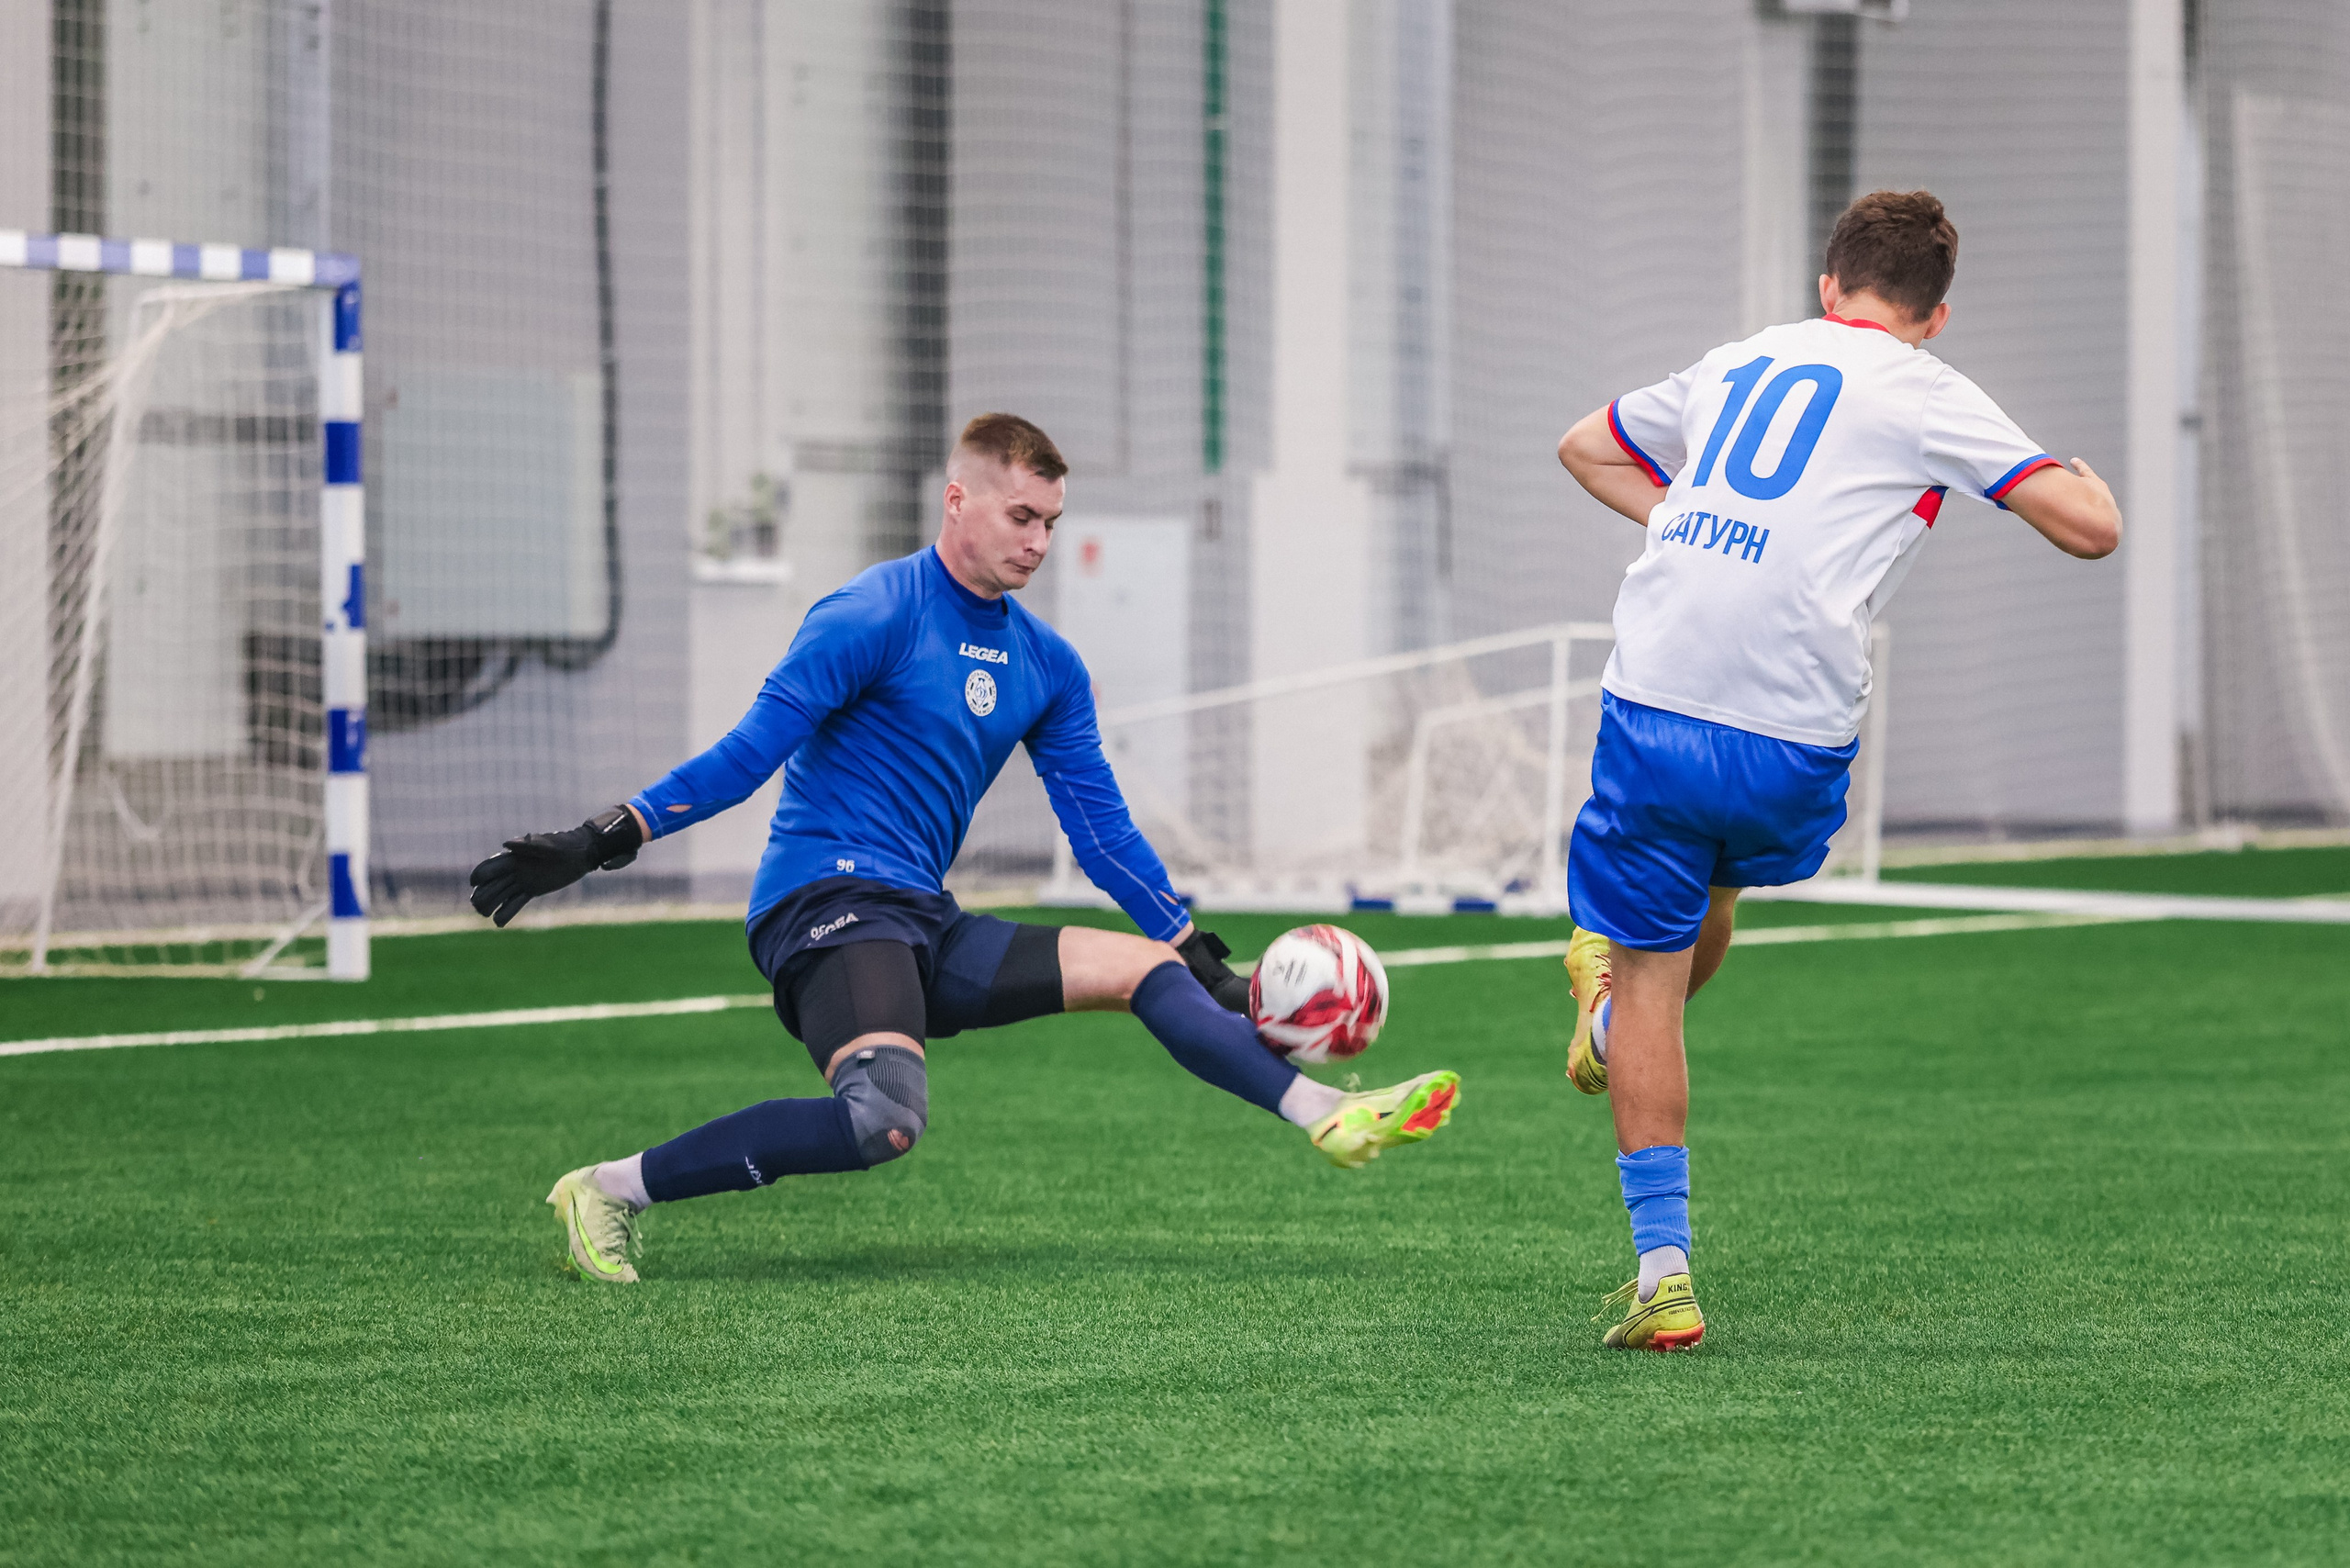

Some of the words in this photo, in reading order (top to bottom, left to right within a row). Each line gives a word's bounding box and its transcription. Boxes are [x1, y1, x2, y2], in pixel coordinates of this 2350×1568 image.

[1692, 355, 1843, 500] 10
[1661, 511, 1770, 564] САТУРН
[958, 642, 1008, 665] LEGEA
[836, 858, 855, 873] 96
